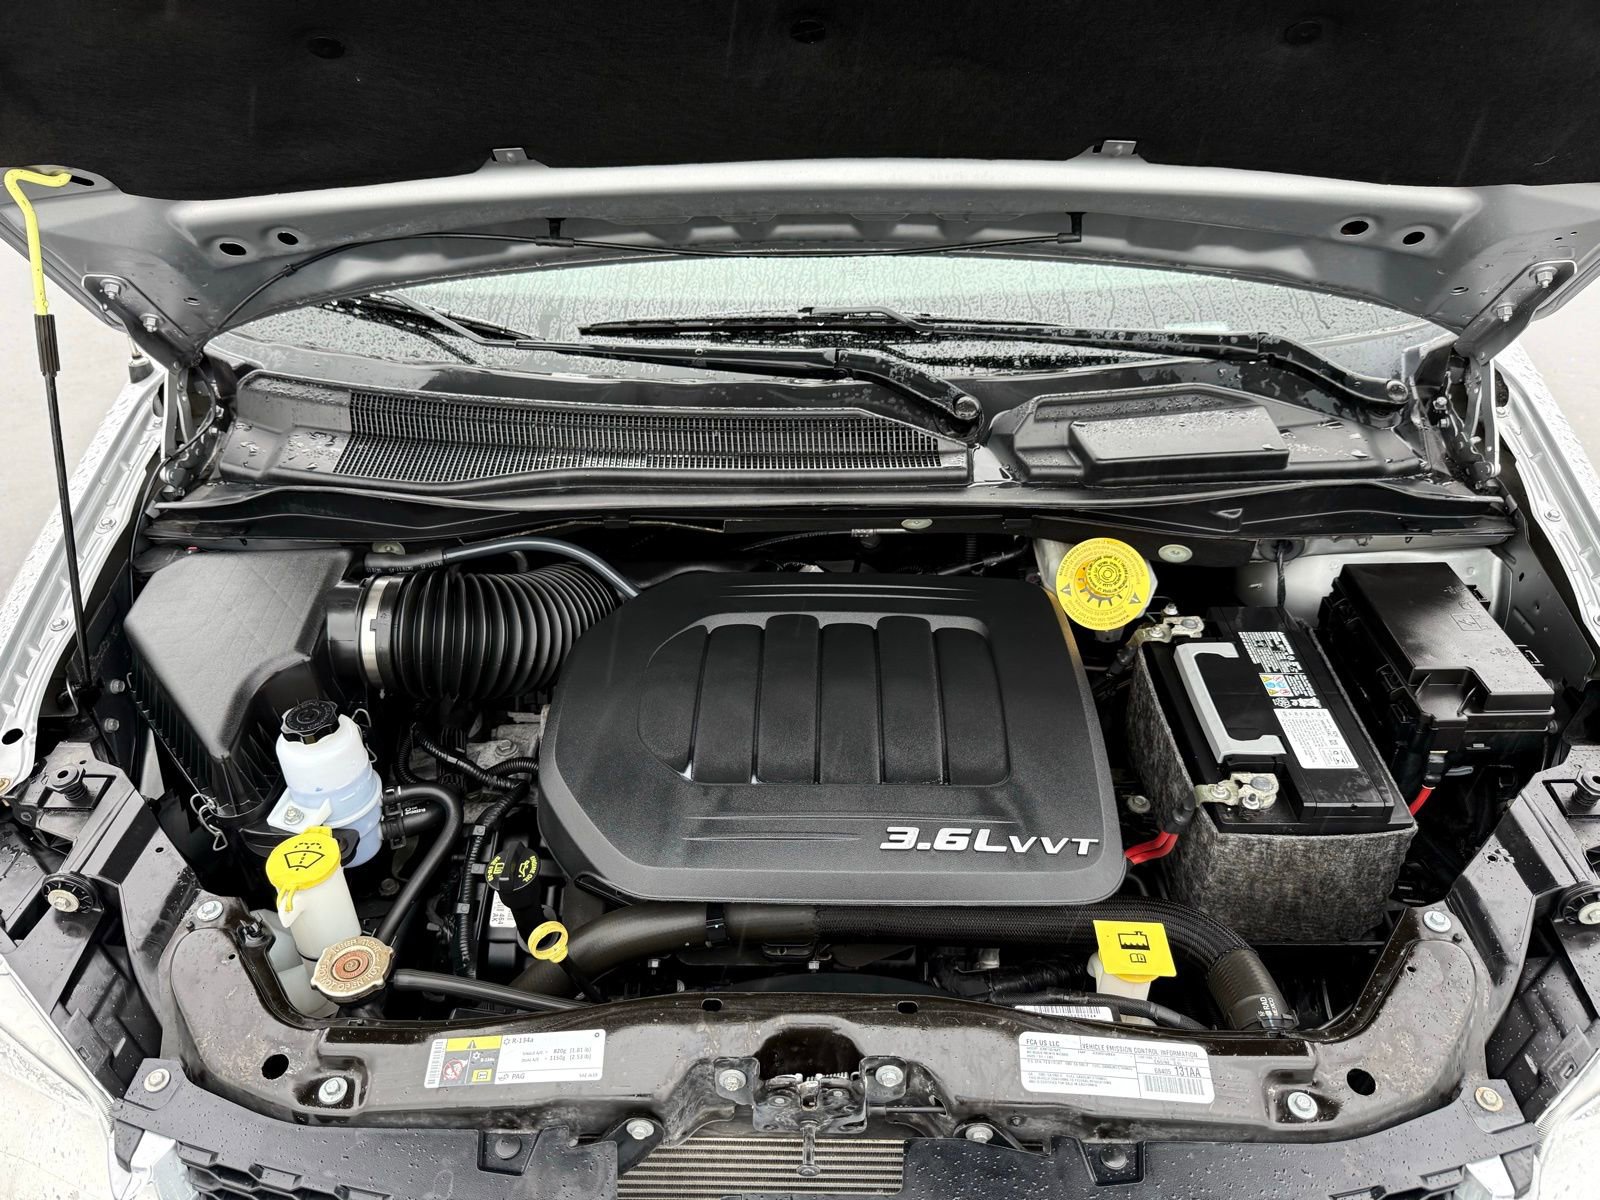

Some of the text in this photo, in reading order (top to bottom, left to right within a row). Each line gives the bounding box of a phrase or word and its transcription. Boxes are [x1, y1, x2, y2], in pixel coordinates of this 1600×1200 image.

[1039, 1039, 1048, 1047] US
[1082, 1043, 1105, 1051] VEHICLE
[1106, 1044, 1133, 1053] EMISSION
[1133, 1047, 1159, 1056] CONTROL
[1160, 1049, 1199, 1058] INFORMATION
[1175, 1066, 1202, 1078] 131AA
